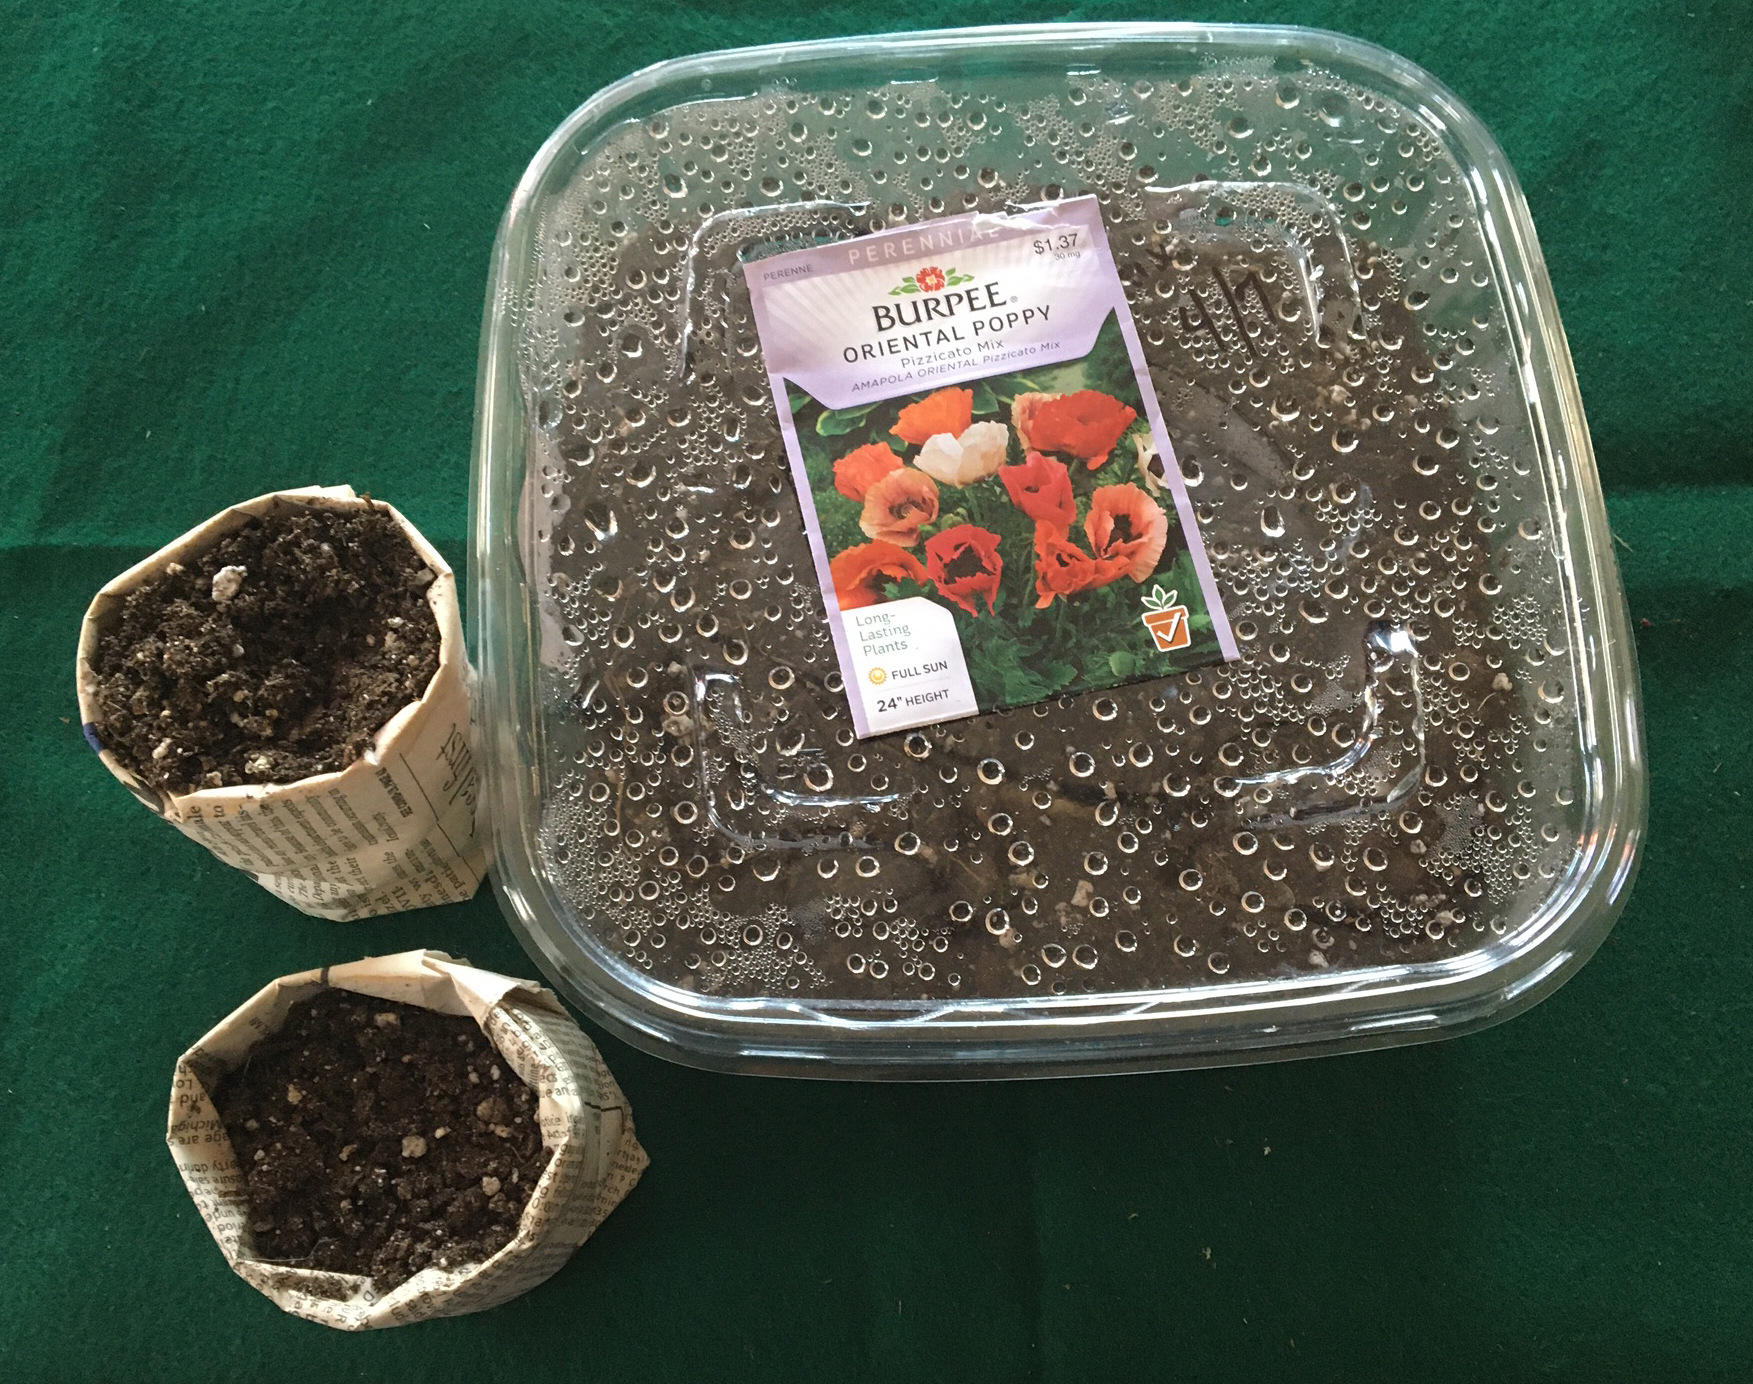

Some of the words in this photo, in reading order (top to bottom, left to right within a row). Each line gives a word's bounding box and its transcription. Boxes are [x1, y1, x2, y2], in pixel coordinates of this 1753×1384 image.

[1033, 233, 1078, 255] $1.37
[1055, 252, 1065, 261] 30
[1067, 250, 1081, 259] mg
[763, 264, 813, 281] PERENNE
[871, 281, 1007, 332] BURPEE
[843, 326, 965, 364] ORIENTAL
[972, 304, 1050, 337] POPPY
[900, 346, 972, 369] Pizzicato
[977, 338, 1004, 352] Mix
[851, 370, 913, 392] AMAPOLA
[917, 359, 978, 378] ORIENTAL
[982, 346, 1037, 364] Pizzicato
[1040, 341, 1061, 352] Mix
[855, 612, 896, 628] Long-
[859, 624, 911, 642] Lasting
[863, 639, 908, 657] Plants
[891, 666, 921, 681] FULL
[923, 660, 949, 675] SUN
[877, 695, 902, 713] 24"
[905, 688, 950, 707] HEIGHT
